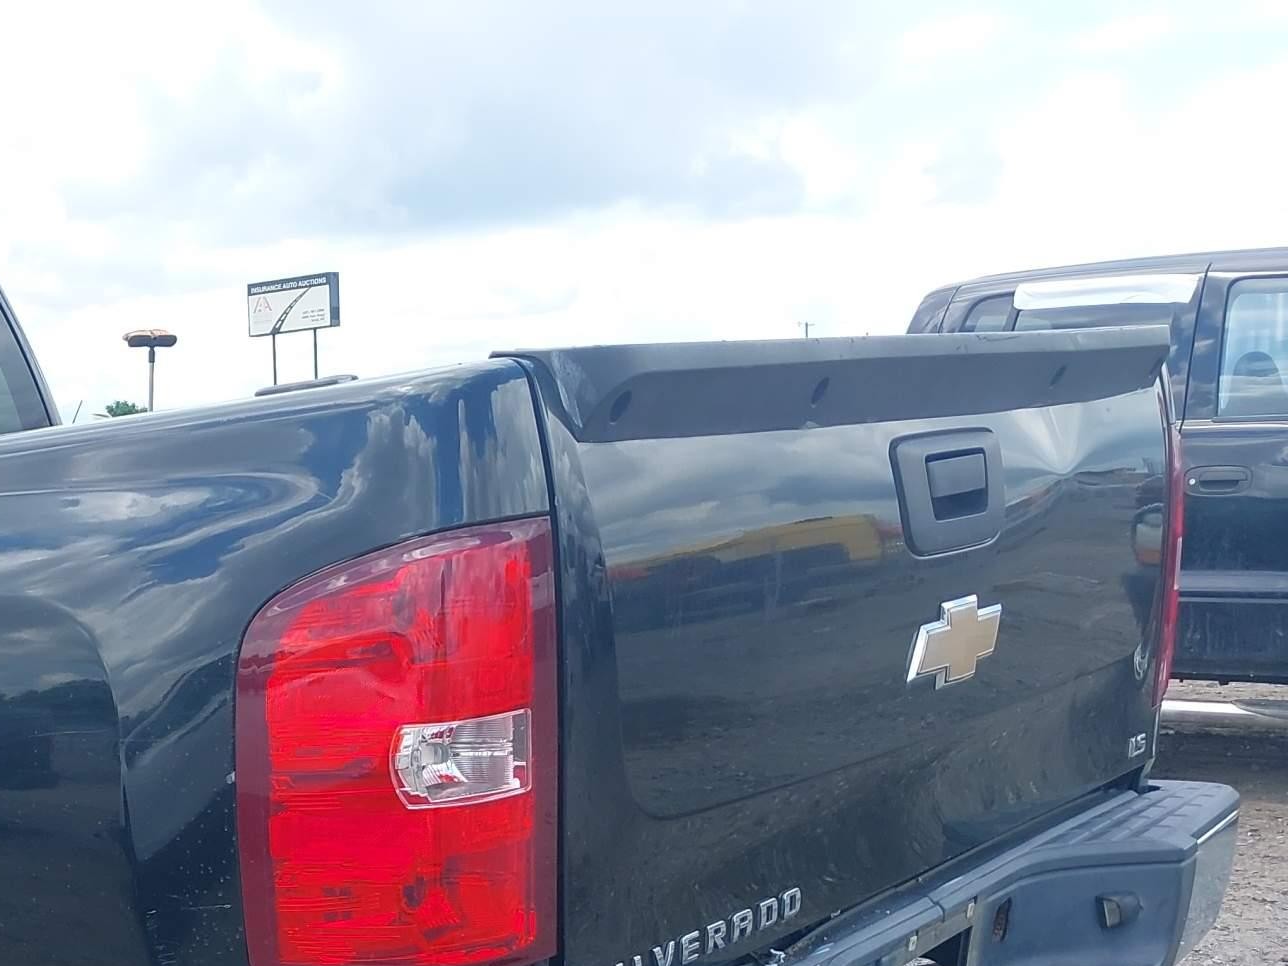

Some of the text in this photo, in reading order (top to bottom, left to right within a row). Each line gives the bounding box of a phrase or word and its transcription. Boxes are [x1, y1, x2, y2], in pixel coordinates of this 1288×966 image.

[250, 276, 327, 294] INSURANCE AUTO AUCTIONS
